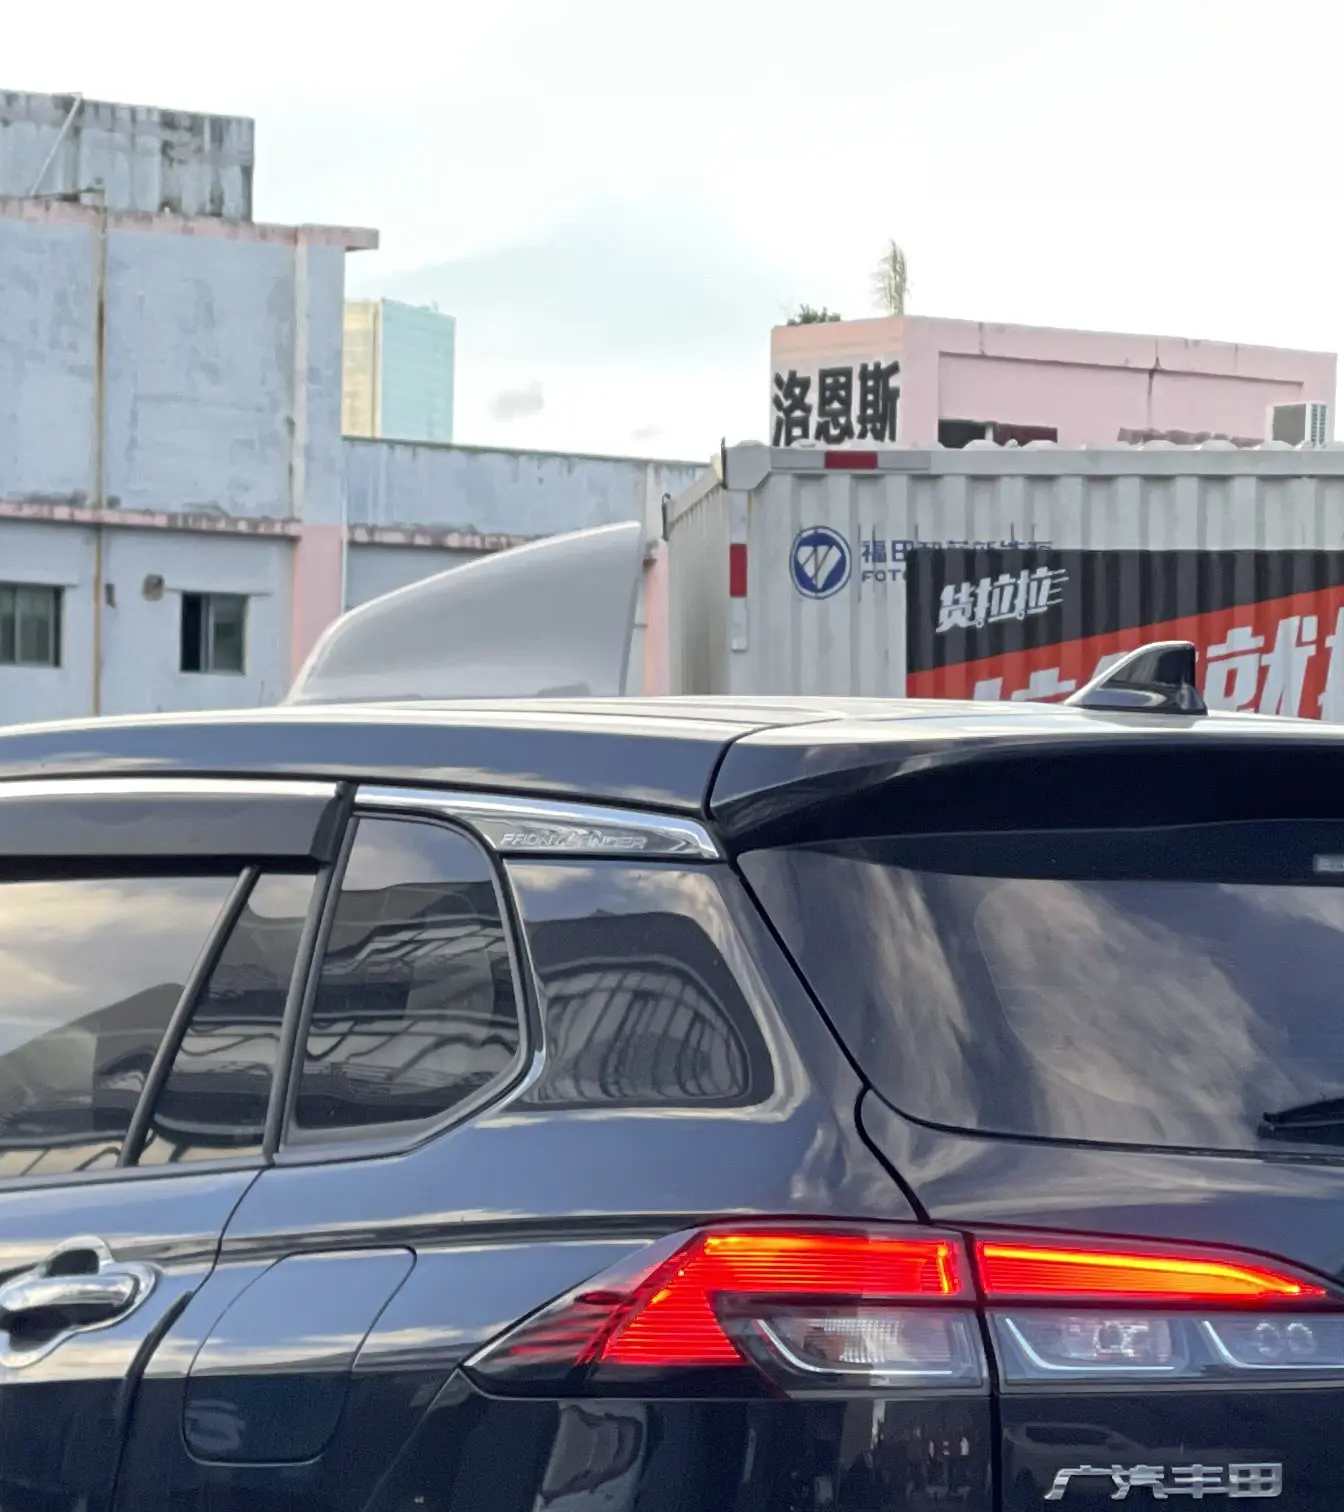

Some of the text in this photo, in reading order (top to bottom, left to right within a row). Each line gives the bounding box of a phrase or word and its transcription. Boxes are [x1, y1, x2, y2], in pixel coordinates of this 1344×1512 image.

[772, 360, 901, 447] 洛恩斯
[862, 569, 906, 582] FOT
[936, 566, 1069, 633] 货拉拉
[1044, 1463, 1283, 1500] 广汽丰田
